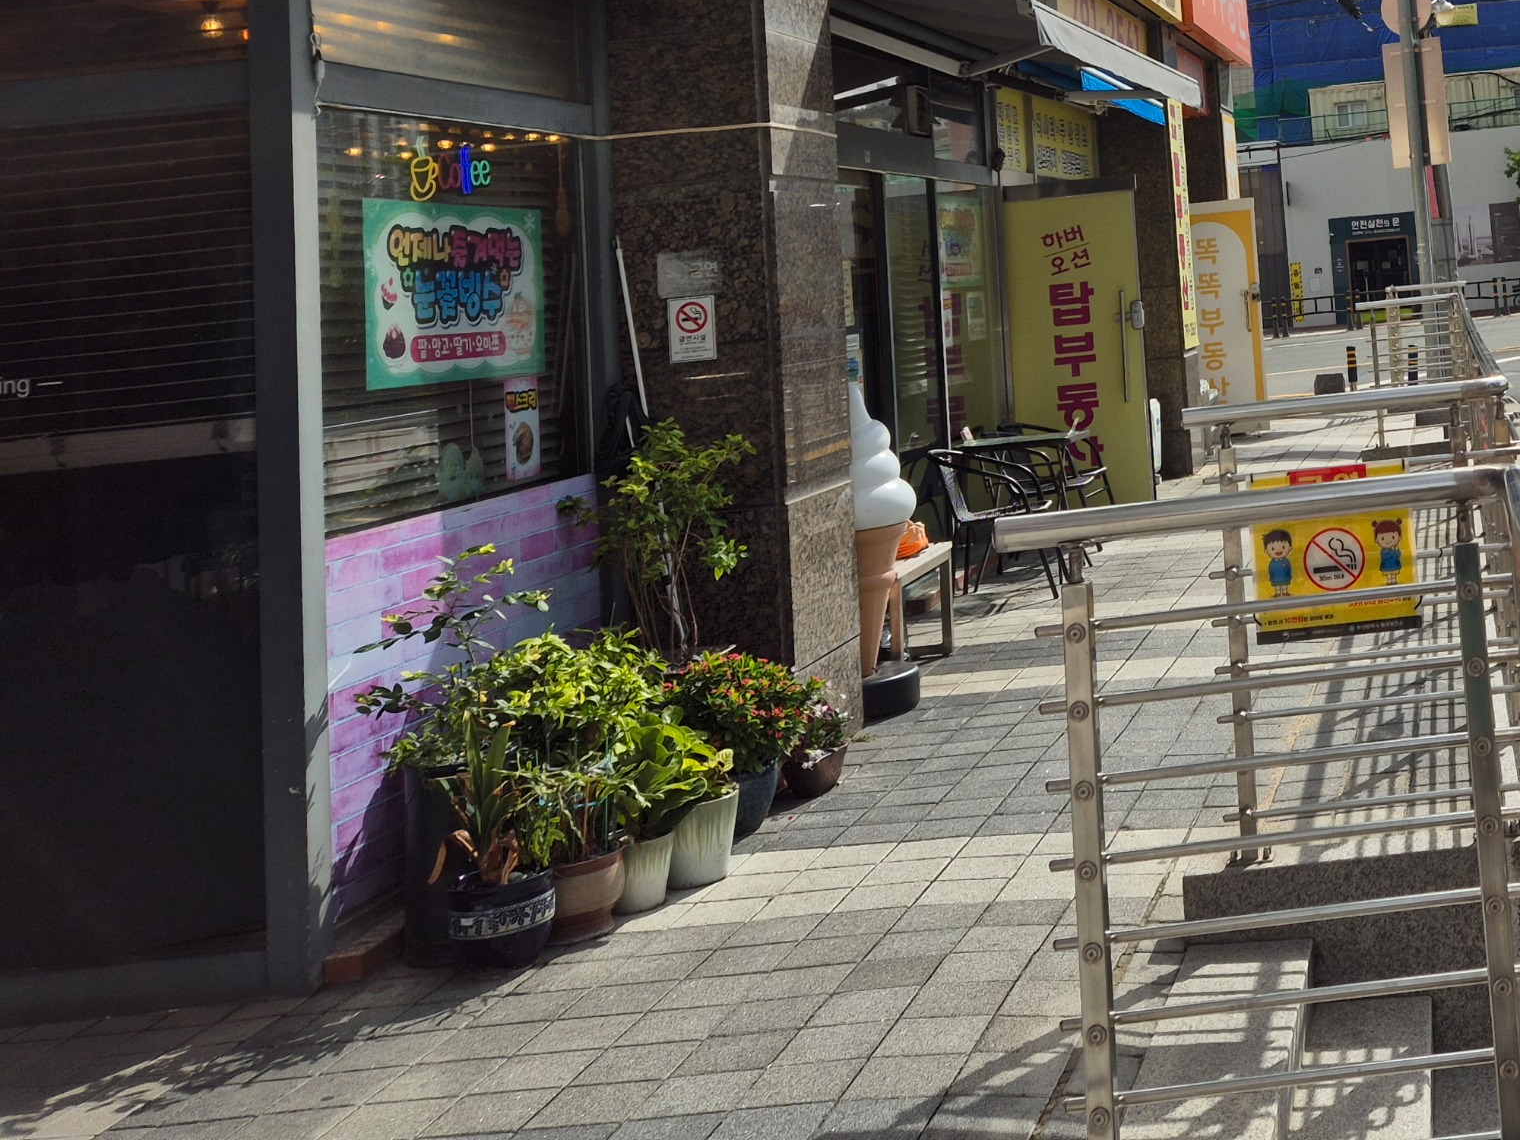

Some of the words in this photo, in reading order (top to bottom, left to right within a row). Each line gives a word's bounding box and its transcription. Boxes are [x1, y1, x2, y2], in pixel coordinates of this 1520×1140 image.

[389, 226, 451, 267] 언제나
[1041, 225, 1085, 249] 하버
[1050, 248, 1091, 276] 오션
